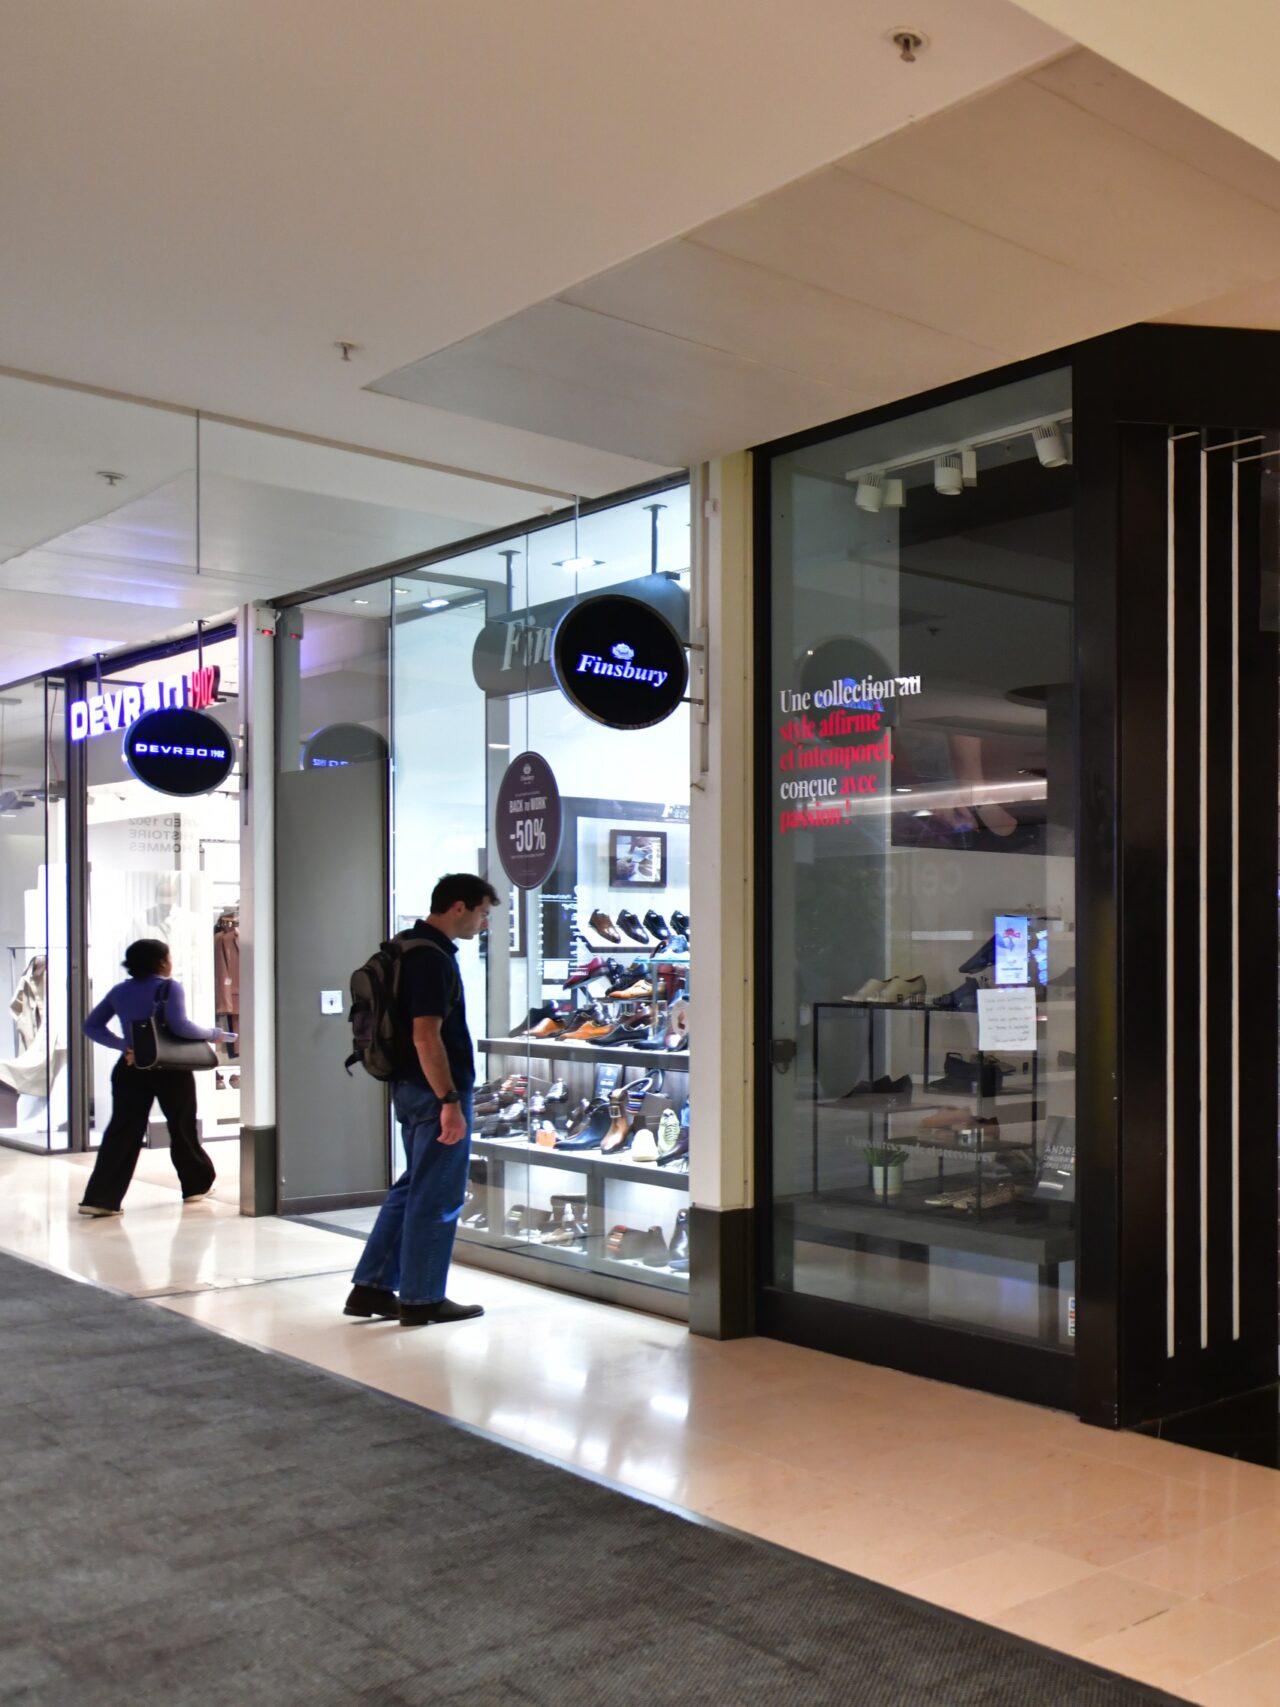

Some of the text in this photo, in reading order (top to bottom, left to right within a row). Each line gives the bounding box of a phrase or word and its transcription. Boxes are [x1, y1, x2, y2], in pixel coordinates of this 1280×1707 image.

[501, 615, 552, 671] Fin
[577, 654, 668, 687] Finsbury
[780, 689, 811, 713] Une
[814, 675, 896, 708] collection
[779, 714, 817, 747] style
[780, 777, 838, 803] conçue
[779, 801, 842, 834] passion
[509, 818, 546, 852] -50%
